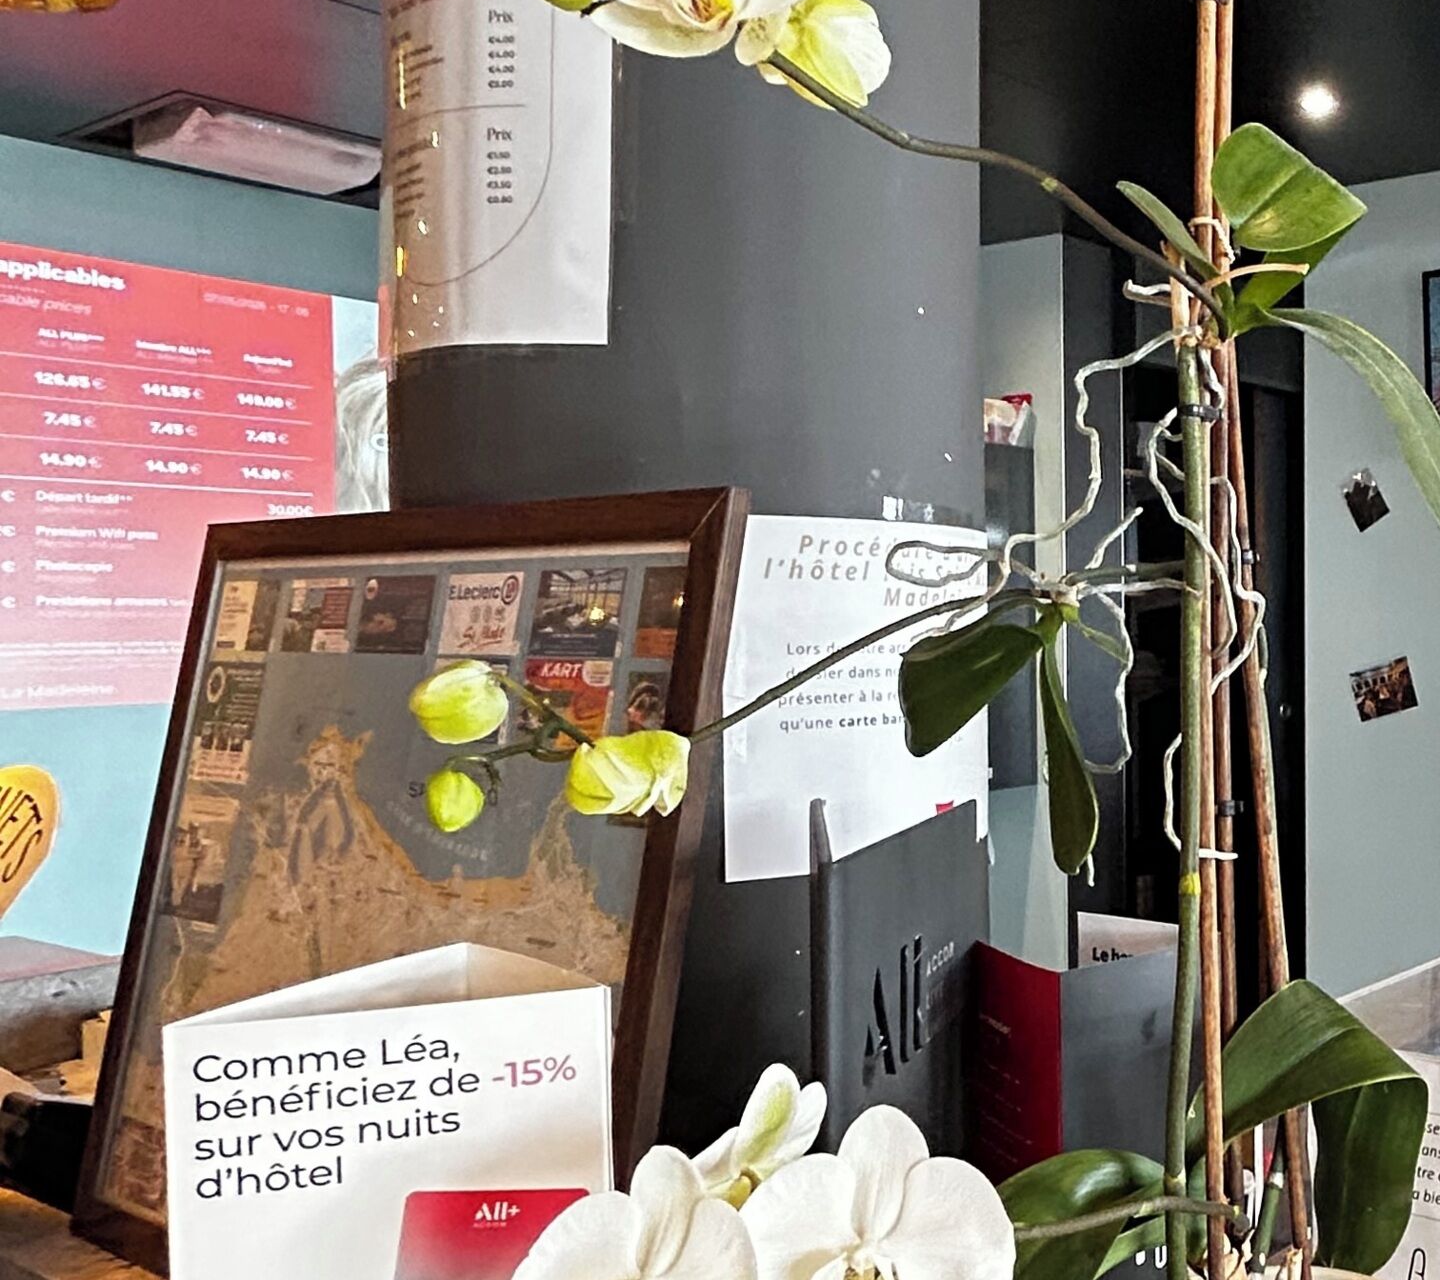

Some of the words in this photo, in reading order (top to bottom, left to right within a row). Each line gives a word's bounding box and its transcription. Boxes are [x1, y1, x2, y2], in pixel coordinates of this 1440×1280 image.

[487, 9, 514, 24] Prix
[486, 127, 512, 141] Prix
[0, 259, 126, 290] applicables
[43, 300, 92, 315] prices
[764, 557, 870, 580] l'hôtel
[786, 643, 820, 655] Lors
[540, 663, 580, 678] KART
[848, 666, 880, 679] dans
[778, 690, 852, 708] présenter
[859, 690, 867, 702] à
[872, 690, 882, 702] la
[779, 718, 833, 733] qu'une
[839, 716, 877, 728] carte
[1092, 947, 1108, 962] Le
[193, 1048, 366, 1082] Comme
[381, 1034, 460, 1066] Léa,
[196, 1077, 417, 1122] bénéficiez
[429, 1068, 480, 1097] de
[491, 1054, 577, 1089] -15%
[195, 1133, 262, 1160] sur
[273, 1125, 344, 1152] vos
[358, 1108, 461, 1143] nuits
[1416, 1166, 1435, 1180] tre
